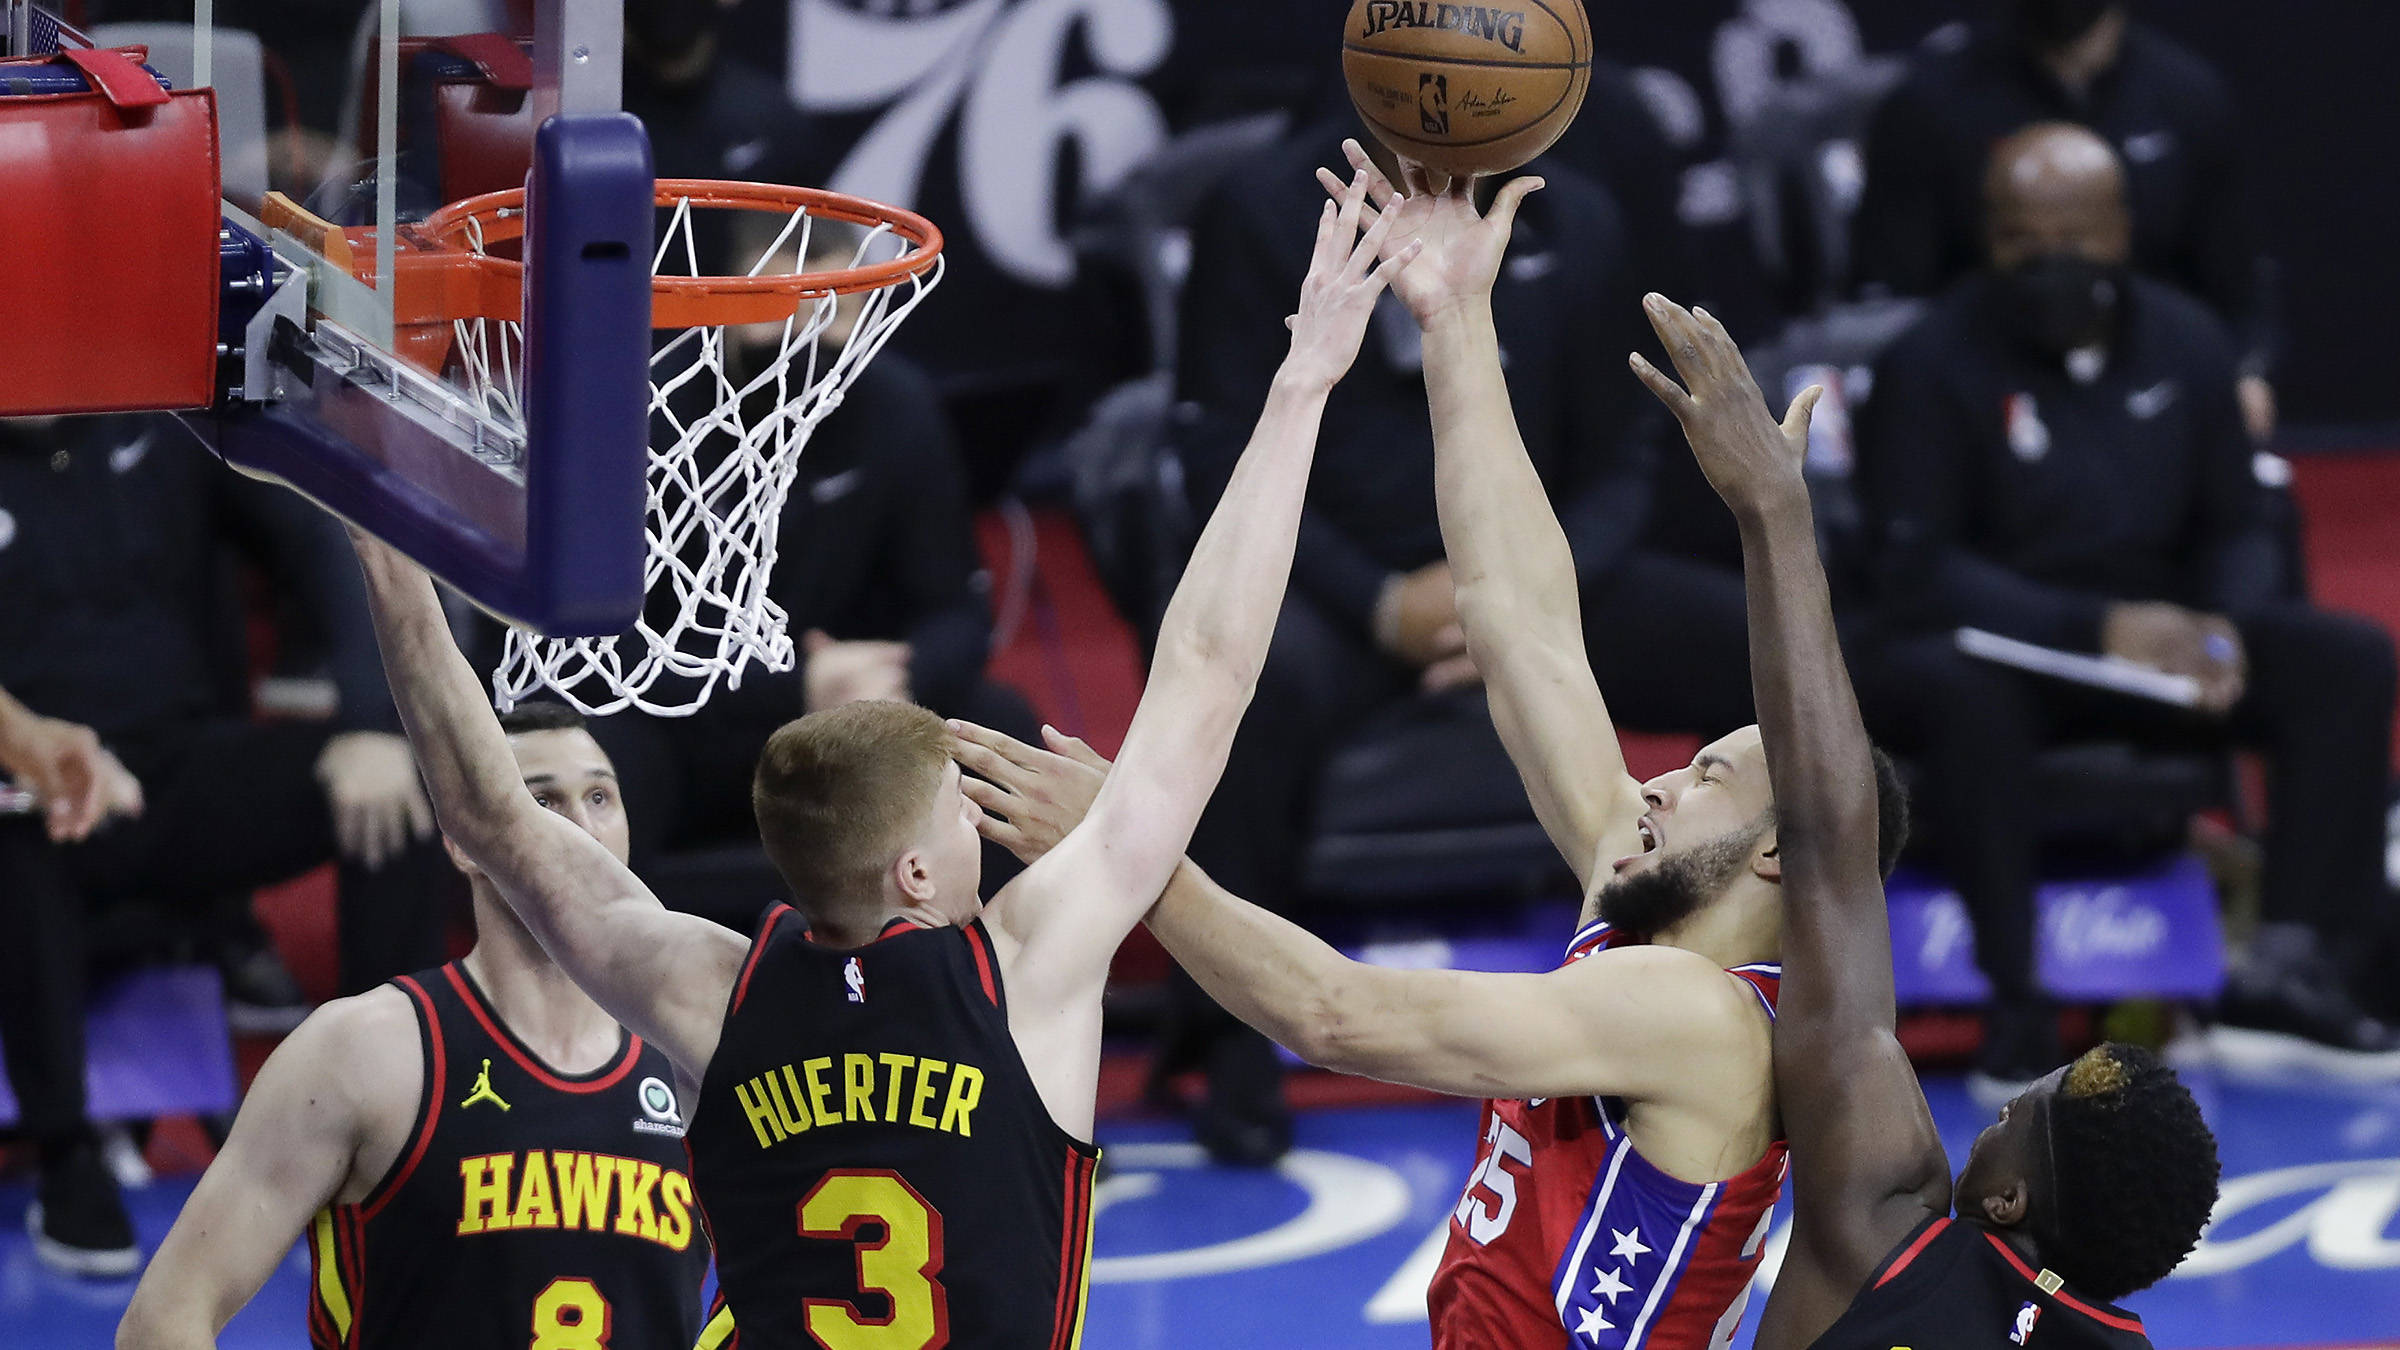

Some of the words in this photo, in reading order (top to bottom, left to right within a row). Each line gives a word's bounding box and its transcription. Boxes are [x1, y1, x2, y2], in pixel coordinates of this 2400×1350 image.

[1362, 0, 1525, 53] SPALDING
[786, 0, 1174, 288] 76
[632, 1118, 687, 1137] sharecar
[734, 1052, 985, 1149] HUERTER
[456, 1149, 694, 1252] HAWKS
[796, 1168, 950, 1350] 3
